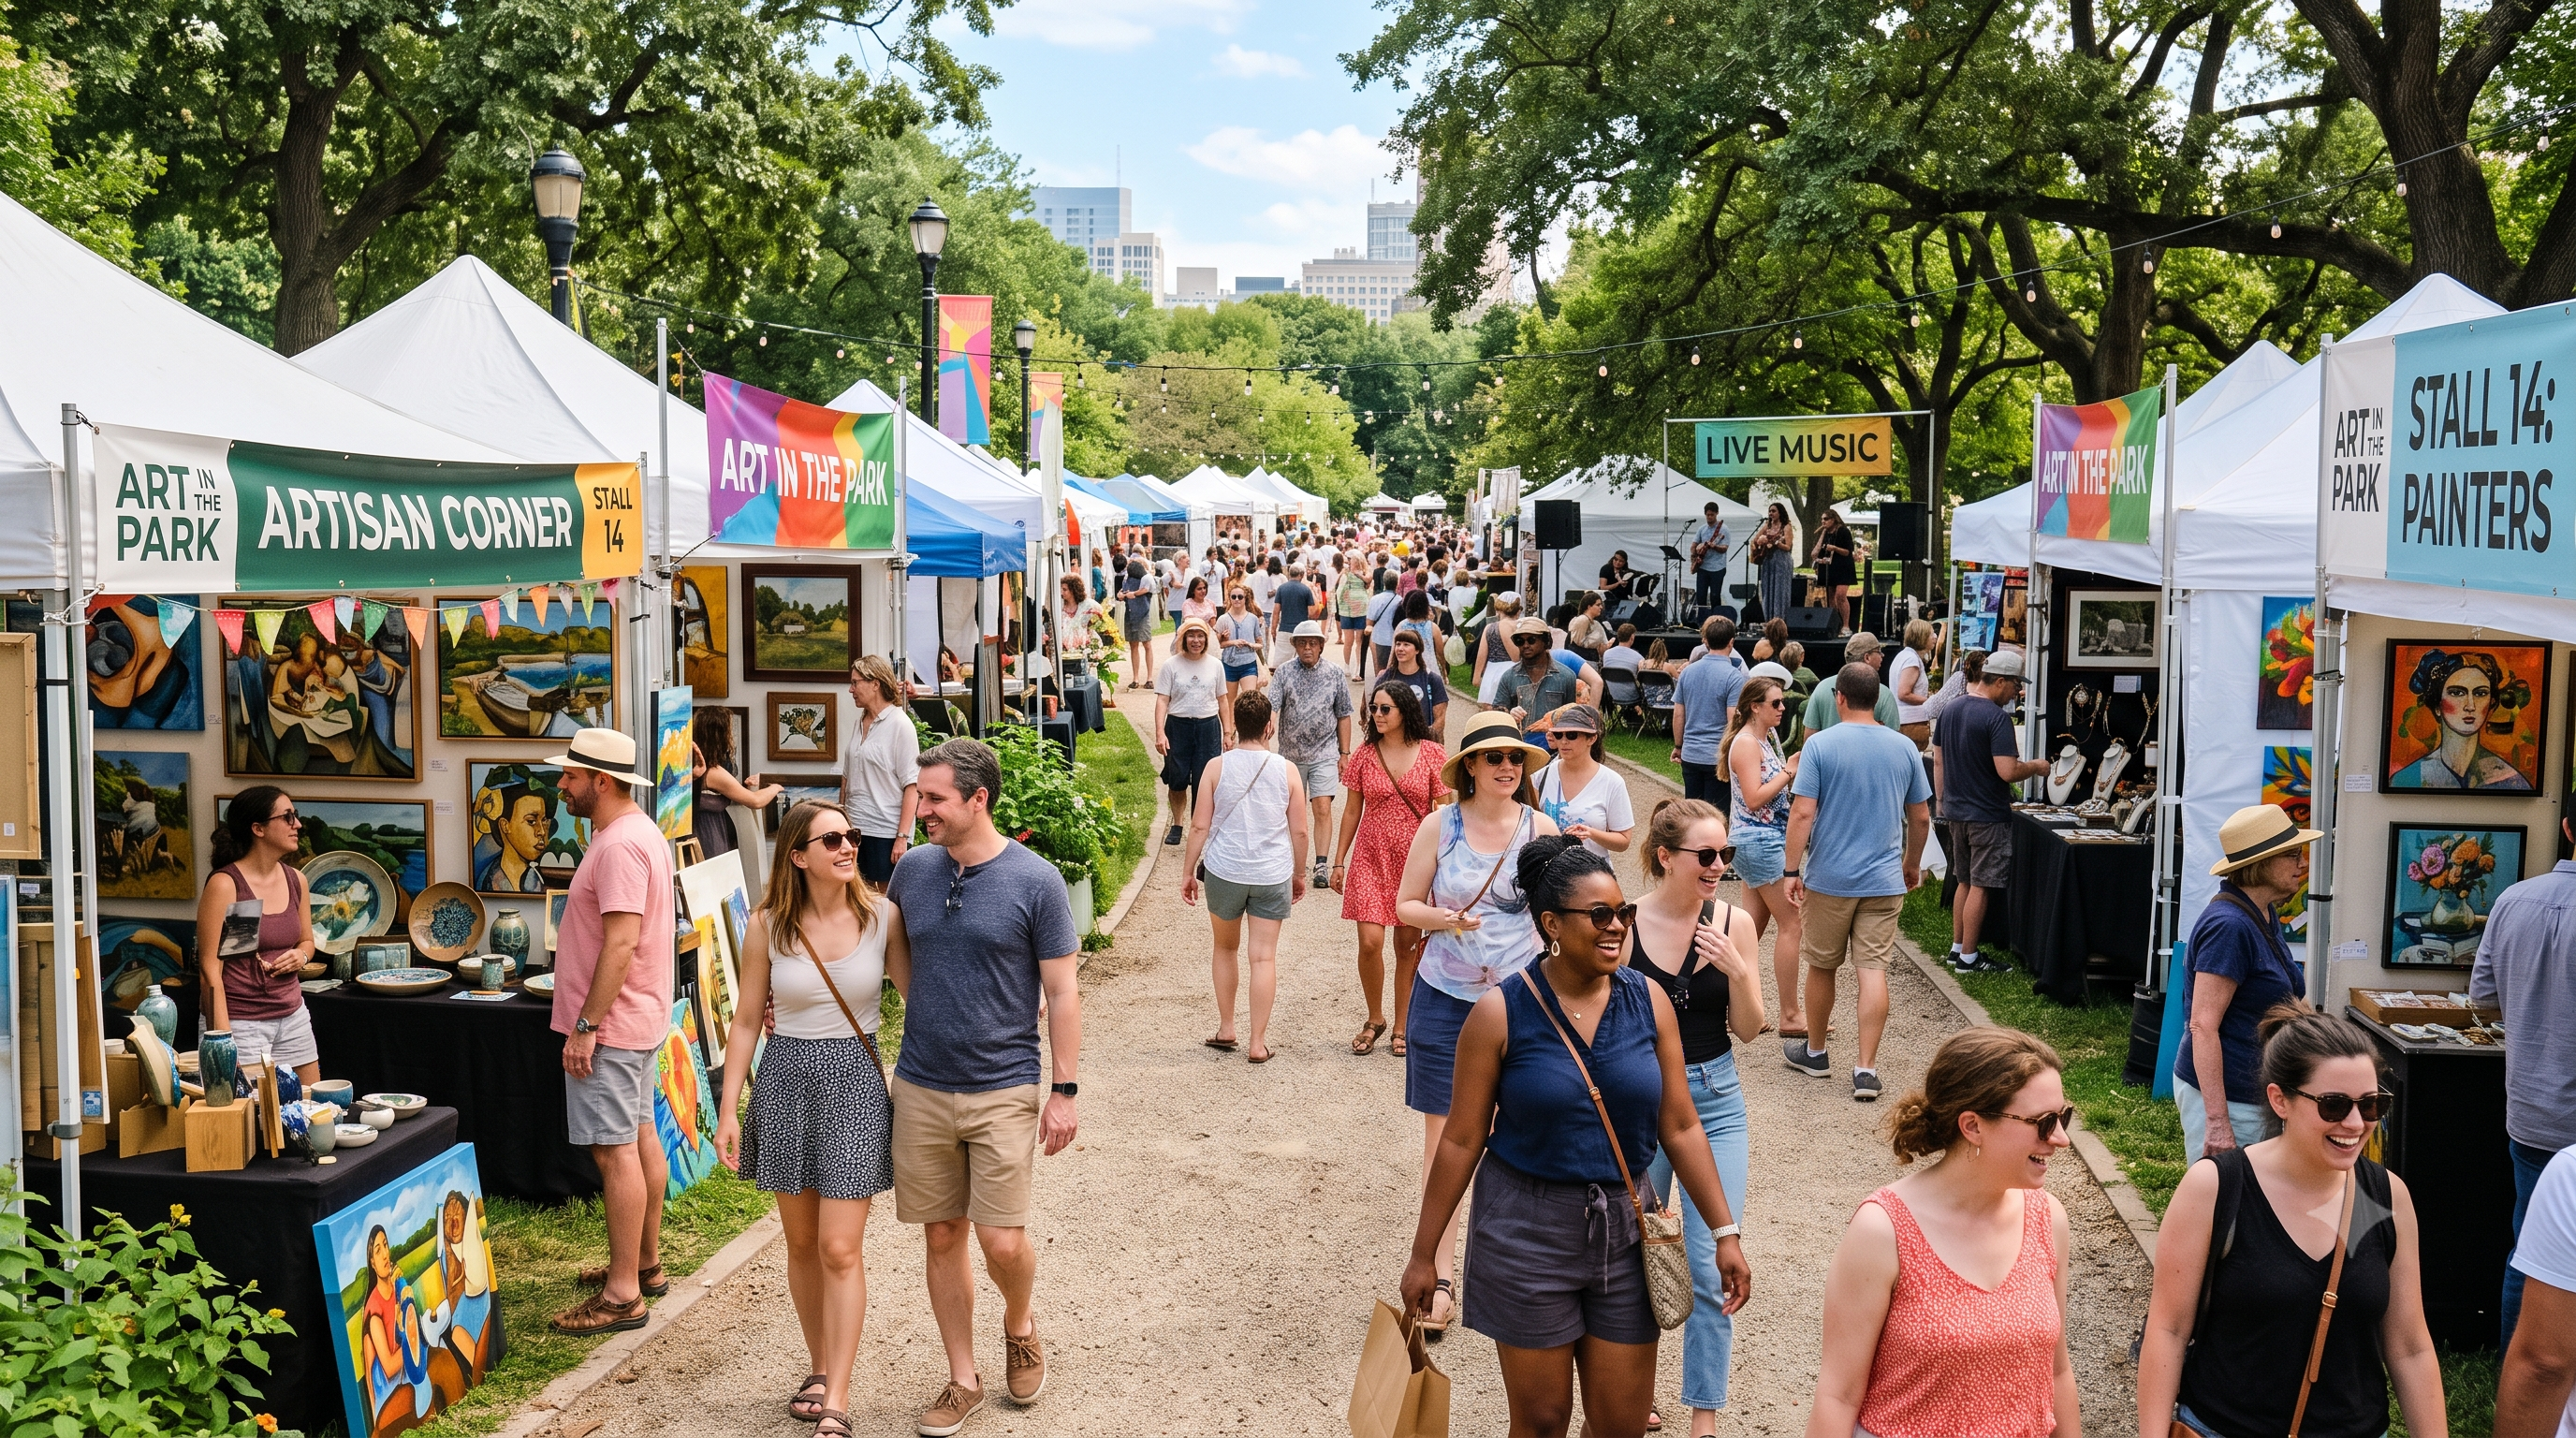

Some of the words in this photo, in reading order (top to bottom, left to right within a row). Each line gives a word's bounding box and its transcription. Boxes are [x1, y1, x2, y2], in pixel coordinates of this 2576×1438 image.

[2372, 407, 2383, 430] IN
[2408, 368, 2498, 451] STALL
[2510, 360, 2555, 445] 14:
[1706, 435, 1770, 464] LIVE
[1779, 433, 1879, 463] MUSIC
[2334, 408, 2370, 458] ART
[2367, 436, 2384, 456] THE
[116, 463, 190, 510] ART
[197, 468, 215, 489] IN
[720, 438, 768, 493] ART
[774, 447, 798, 498] IN
[800, 452, 842, 503] THE
[844, 457, 888, 506] PARK
[2042, 450, 2067, 493] ART
[2067, 450, 2080, 494] IN
[2082, 449, 2107, 495] THE
[2109, 445, 2148, 494] PARK
[2333, 462, 2382, 513] PARK
[195, 494, 221, 511] THE
[257, 486, 436, 550] ARTISAN
[440, 495, 573, 550] CORNER
[593, 487, 633, 510] STALL
[2403, 468, 2554, 552] PAINTERS
[118, 517, 220, 562] PARK
[604, 519, 623, 552] 14
